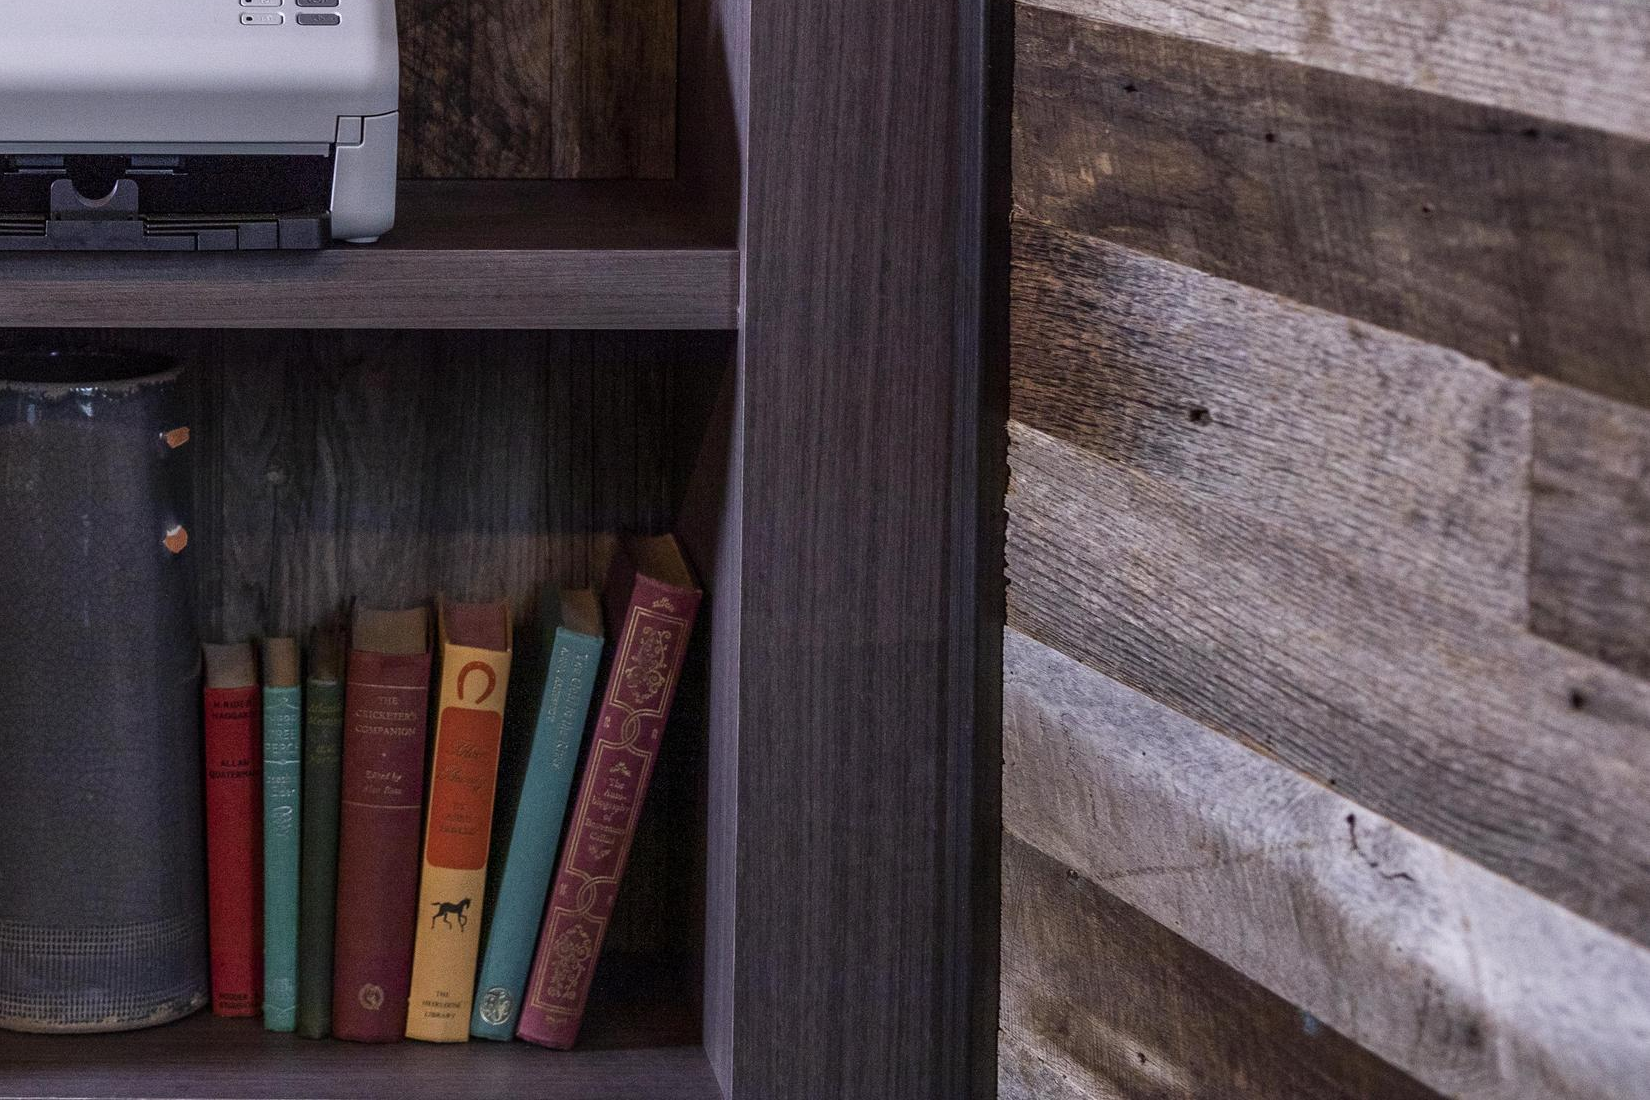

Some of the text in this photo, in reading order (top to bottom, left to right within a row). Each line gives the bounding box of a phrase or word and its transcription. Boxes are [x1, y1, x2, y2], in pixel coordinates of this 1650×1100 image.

[378, 696, 398, 705] THE
[355, 725, 416, 736] COMPANION
[608, 778, 625, 789] The
[603, 789, 627, 800] Auto-
[592, 797, 630, 812] biography
